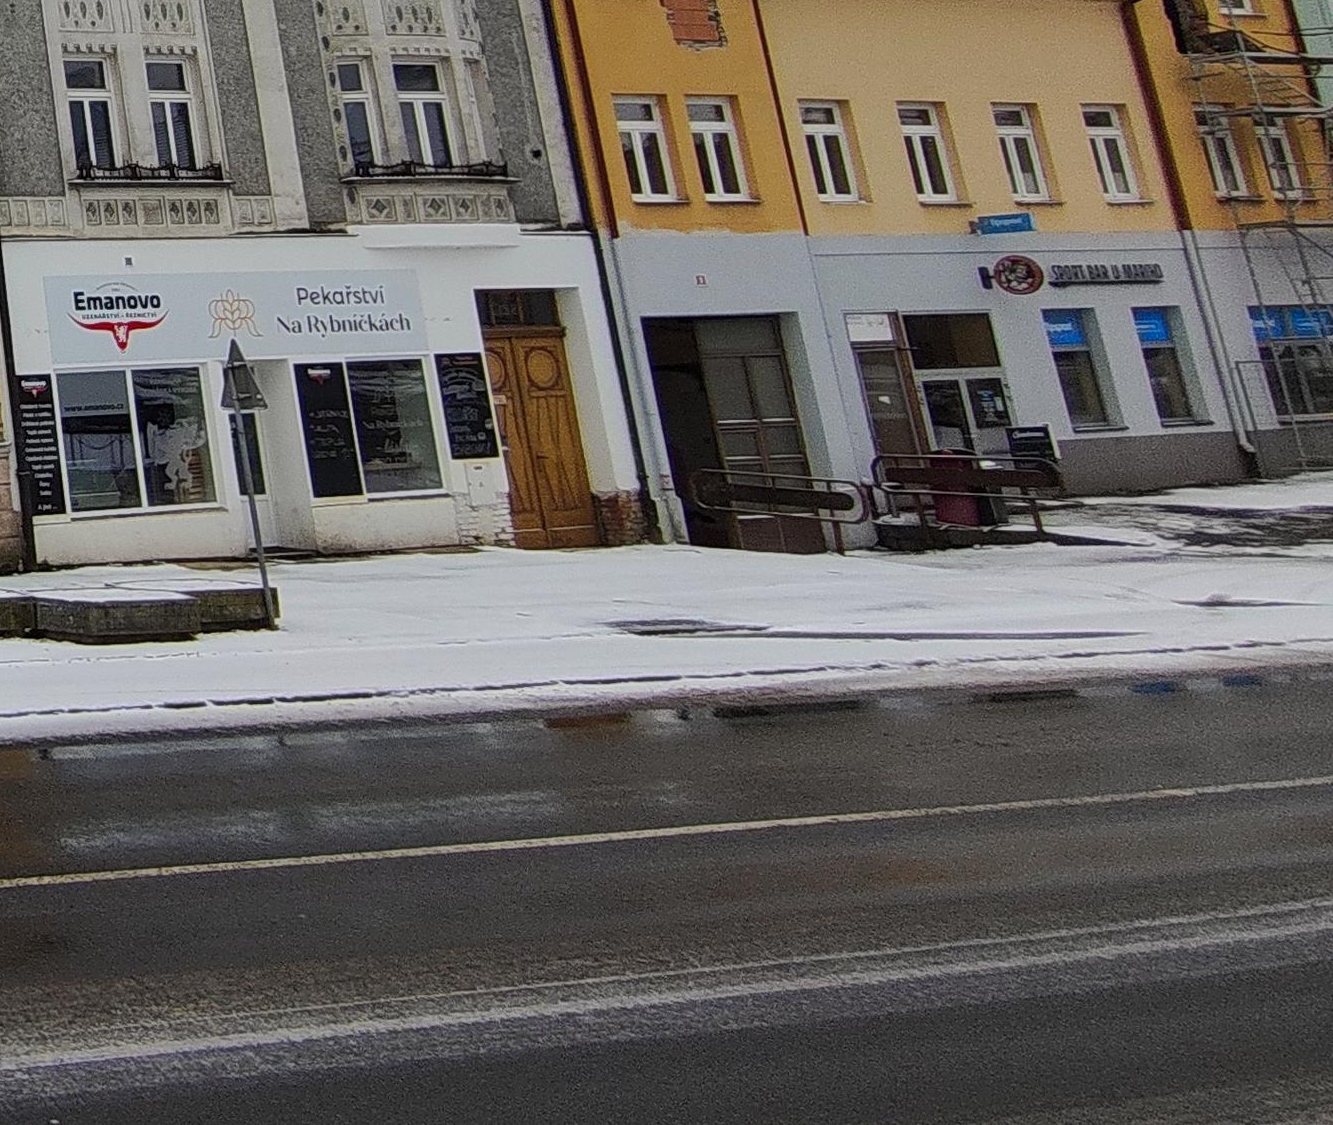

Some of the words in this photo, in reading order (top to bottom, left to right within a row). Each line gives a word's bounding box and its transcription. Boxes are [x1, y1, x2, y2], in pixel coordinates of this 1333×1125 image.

[73, 291, 162, 311] Emanovo
[296, 284, 386, 306] Pekařství
[276, 316, 303, 334] Na
[306, 312, 412, 338] Rybníčkách
